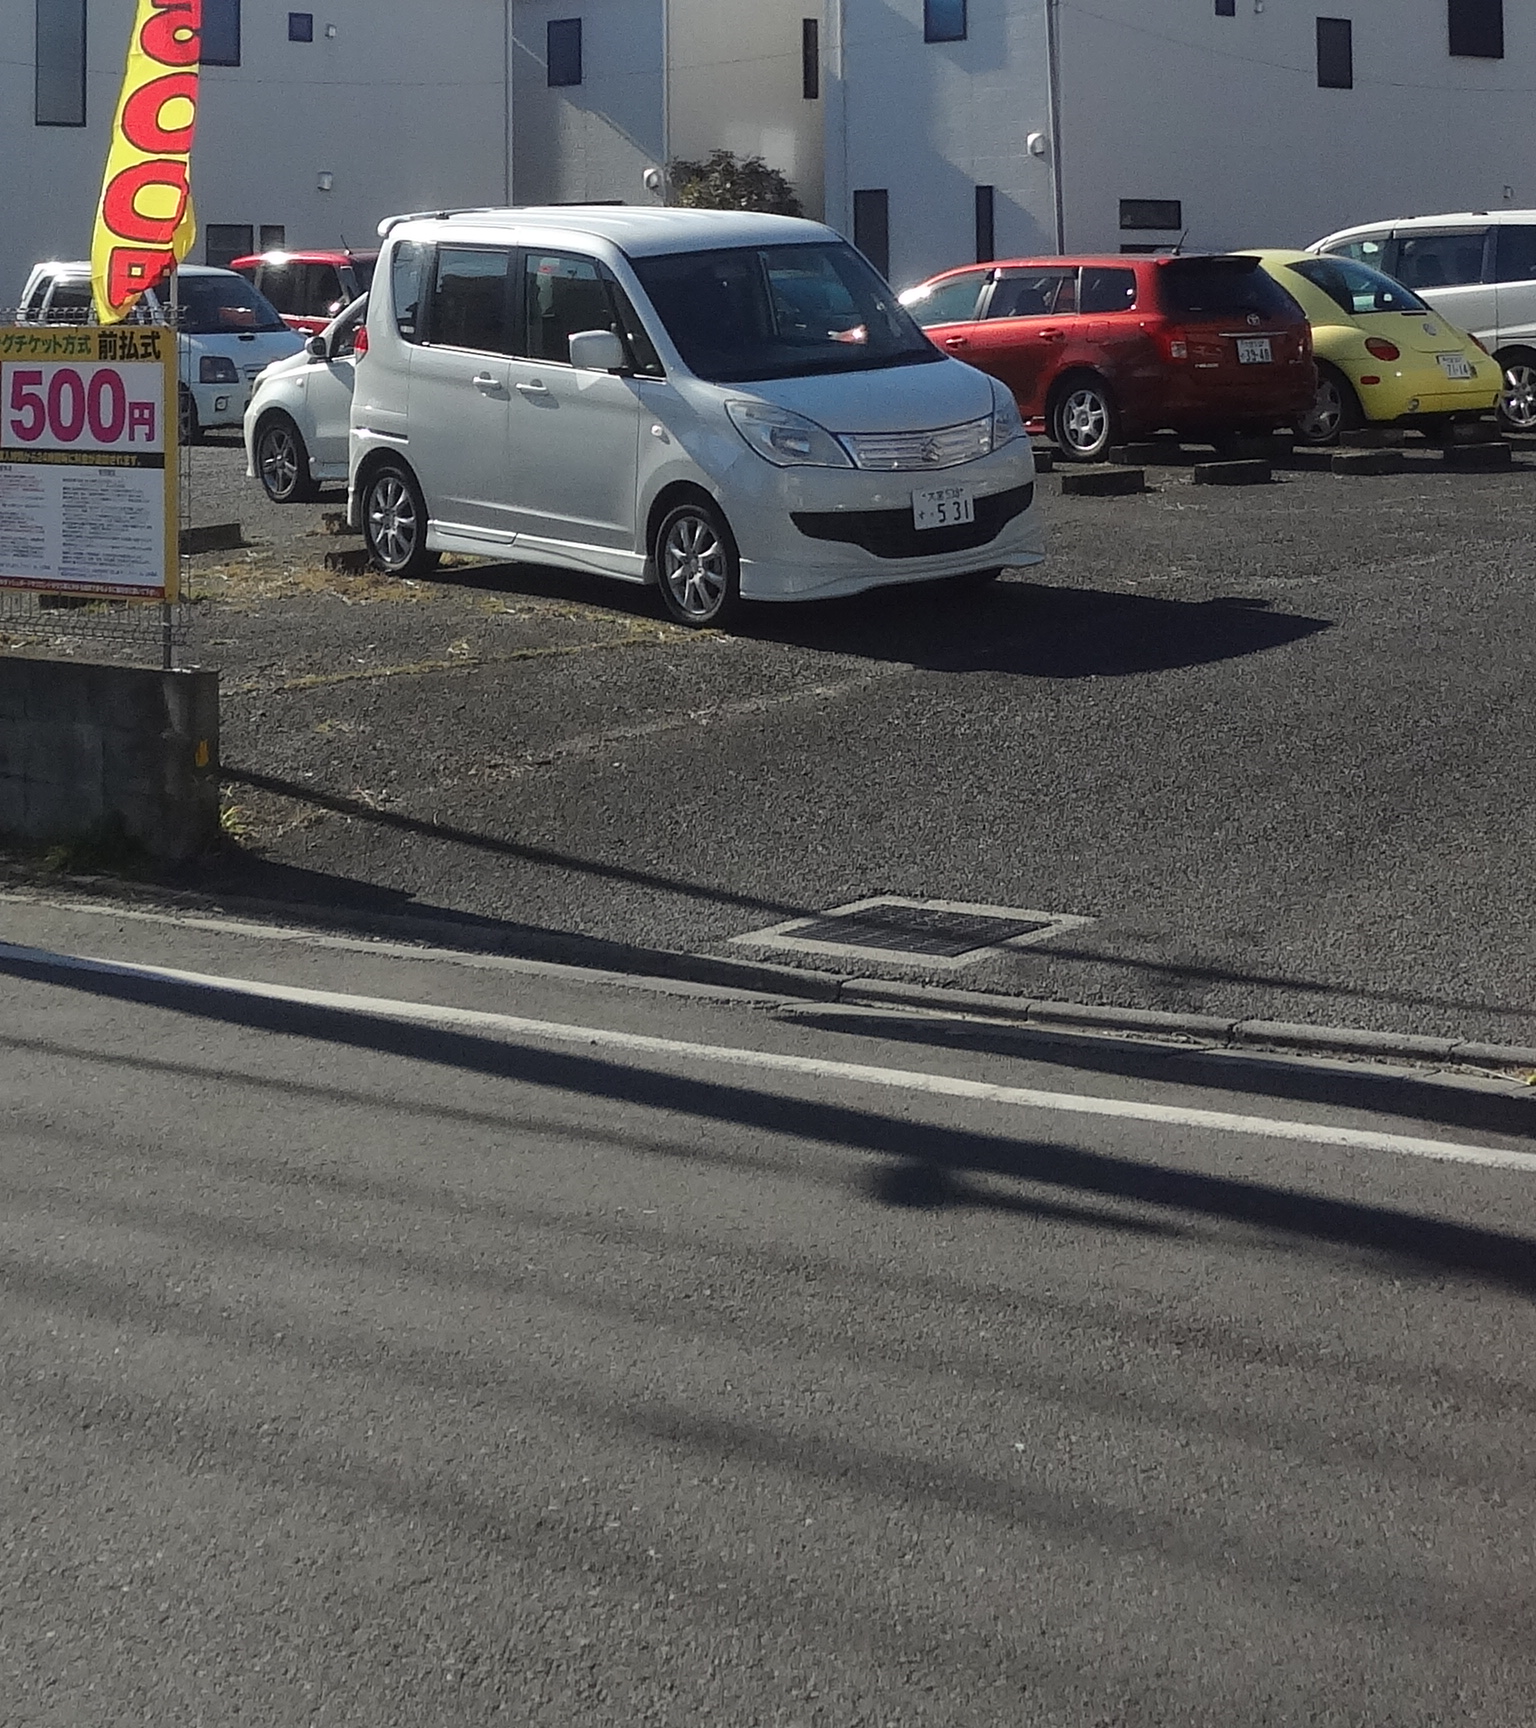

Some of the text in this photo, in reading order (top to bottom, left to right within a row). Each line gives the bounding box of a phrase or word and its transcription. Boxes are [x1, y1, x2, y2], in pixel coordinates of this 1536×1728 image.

[97, 329, 162, 361] 前払式
[10, 368, 155, 443] 500円
